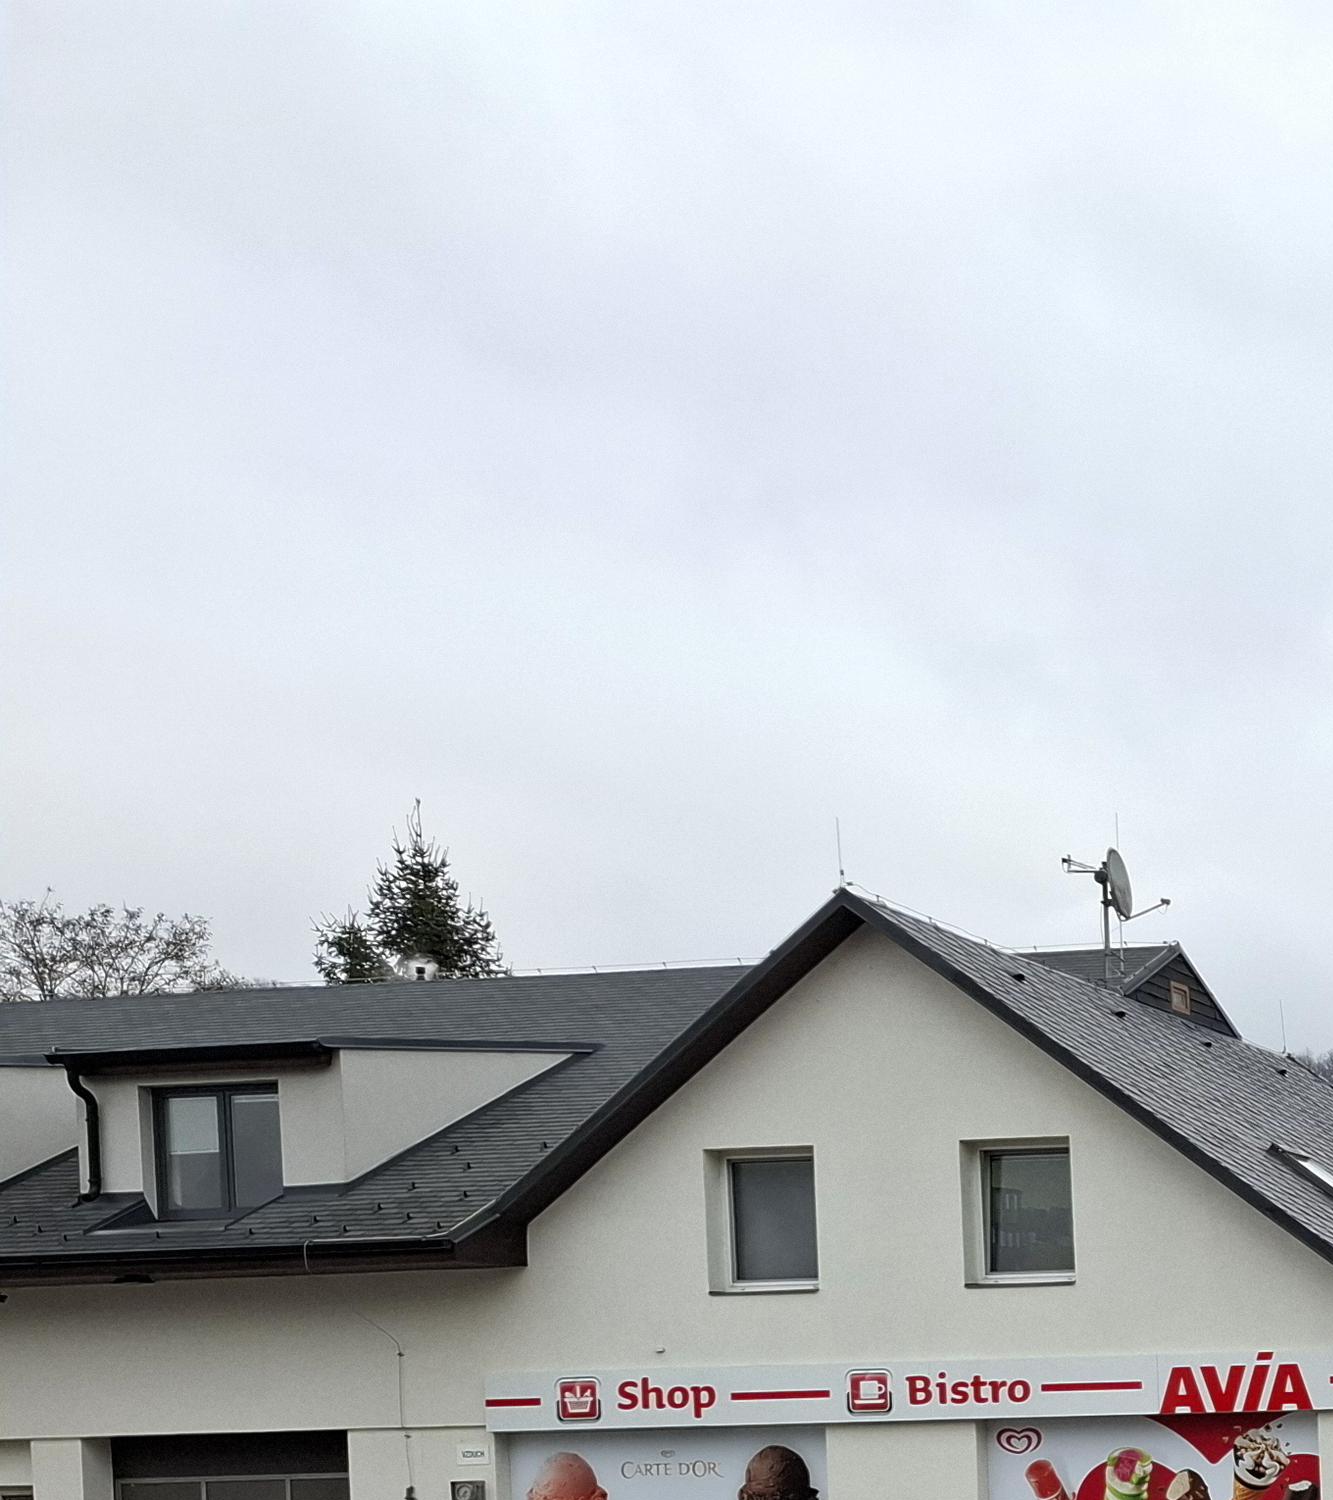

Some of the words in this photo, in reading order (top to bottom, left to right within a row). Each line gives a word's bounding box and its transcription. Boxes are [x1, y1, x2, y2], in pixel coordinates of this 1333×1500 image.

[617, 1376, 716, 1419] Shop
[905, 1371, 1031, 1406] Bistro
[621, 1461, 673, 1479] CARTE
